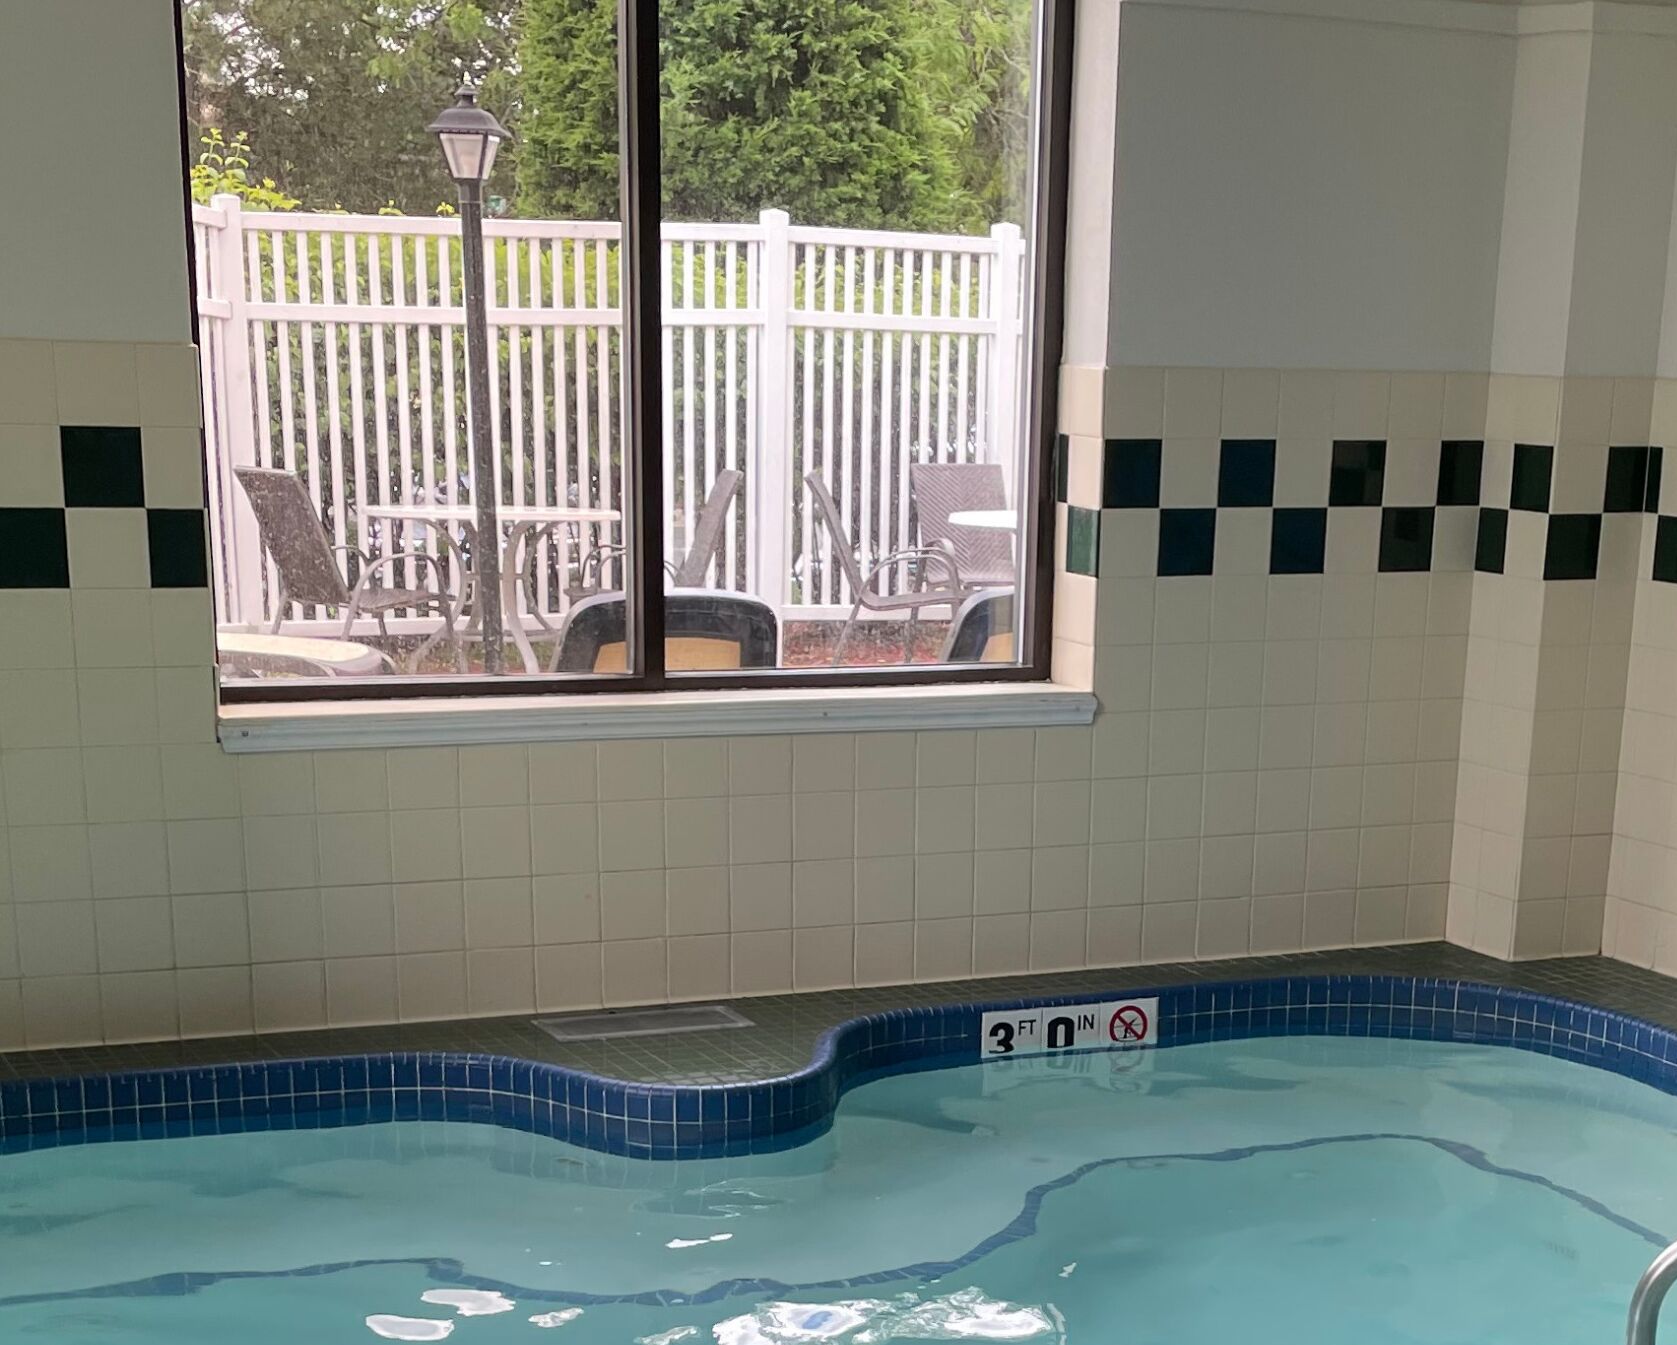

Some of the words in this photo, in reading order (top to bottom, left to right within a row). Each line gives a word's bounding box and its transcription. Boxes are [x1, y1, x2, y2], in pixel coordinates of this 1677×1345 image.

[988, 1022, 1014, 1054] 3
[1018, 1019, 1036, 1036] FT
[1047, 1016, 1075, 1049] 0
[1077, 1014, 1095, 1031] IN
